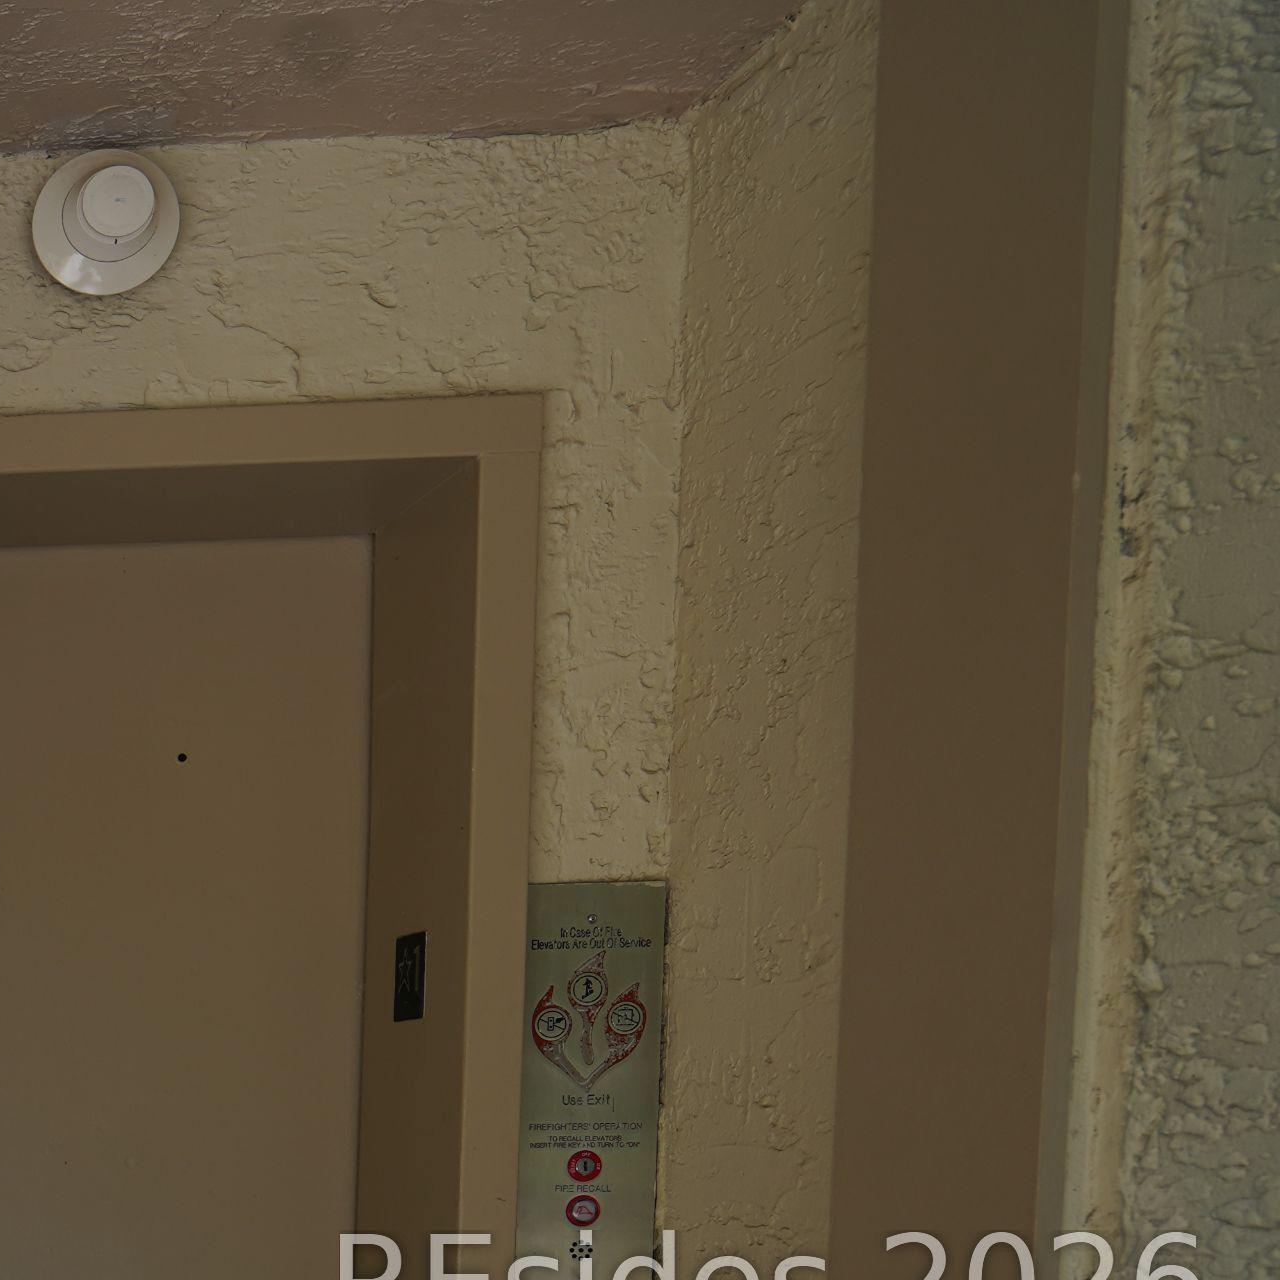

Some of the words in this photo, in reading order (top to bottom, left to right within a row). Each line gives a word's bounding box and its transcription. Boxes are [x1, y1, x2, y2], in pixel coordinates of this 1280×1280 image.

[569, 927, 591, 939] Case
[531, 938, 571, 951] Elevators
[619, 936, 652, 949] Service
[561, 1094, 583, 1106] Use
[587, 1093, 610, 1106] Exit
[555, 1184, 574, 1193] FIRE
[576, 1184, 612, 1193] RECALL
